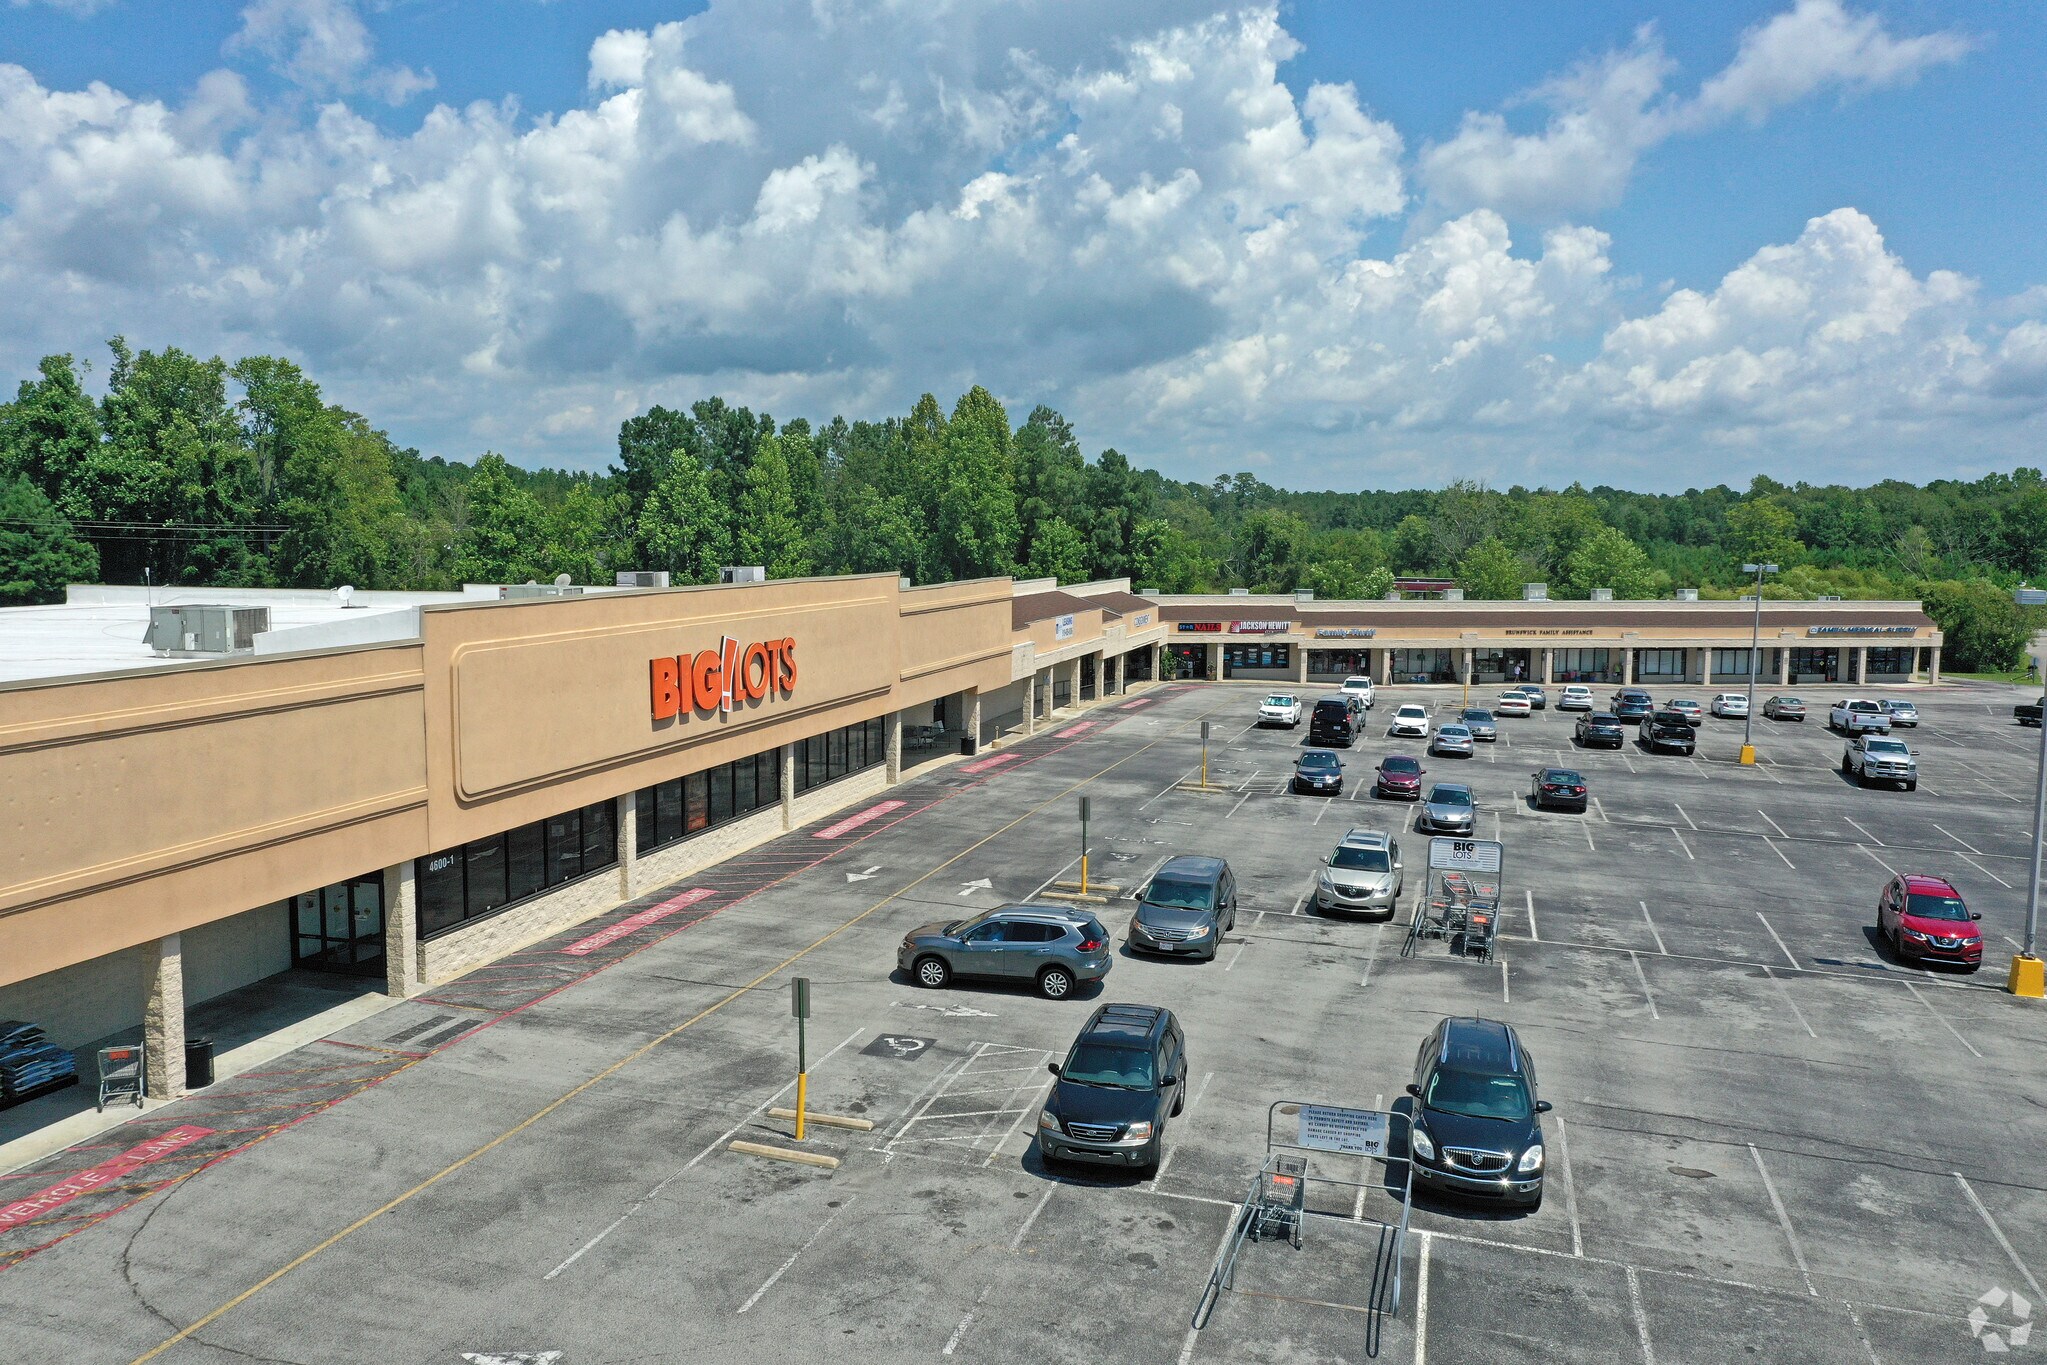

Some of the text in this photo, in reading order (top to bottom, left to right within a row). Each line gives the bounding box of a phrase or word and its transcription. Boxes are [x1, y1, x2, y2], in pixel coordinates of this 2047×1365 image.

[1194, 623, 1221, 631] NAILS
[1240, 621, 1291, 630] JACKSON HEWITT
[1453, 842, 1475, 852] BIG
[1453, 851, 1471, 859] LOTS
[429, 854, 454, 871] 4600-1
[127, 1131, 193, 1161] LANE
[1365, 1140, 1379, 1148] BIG
